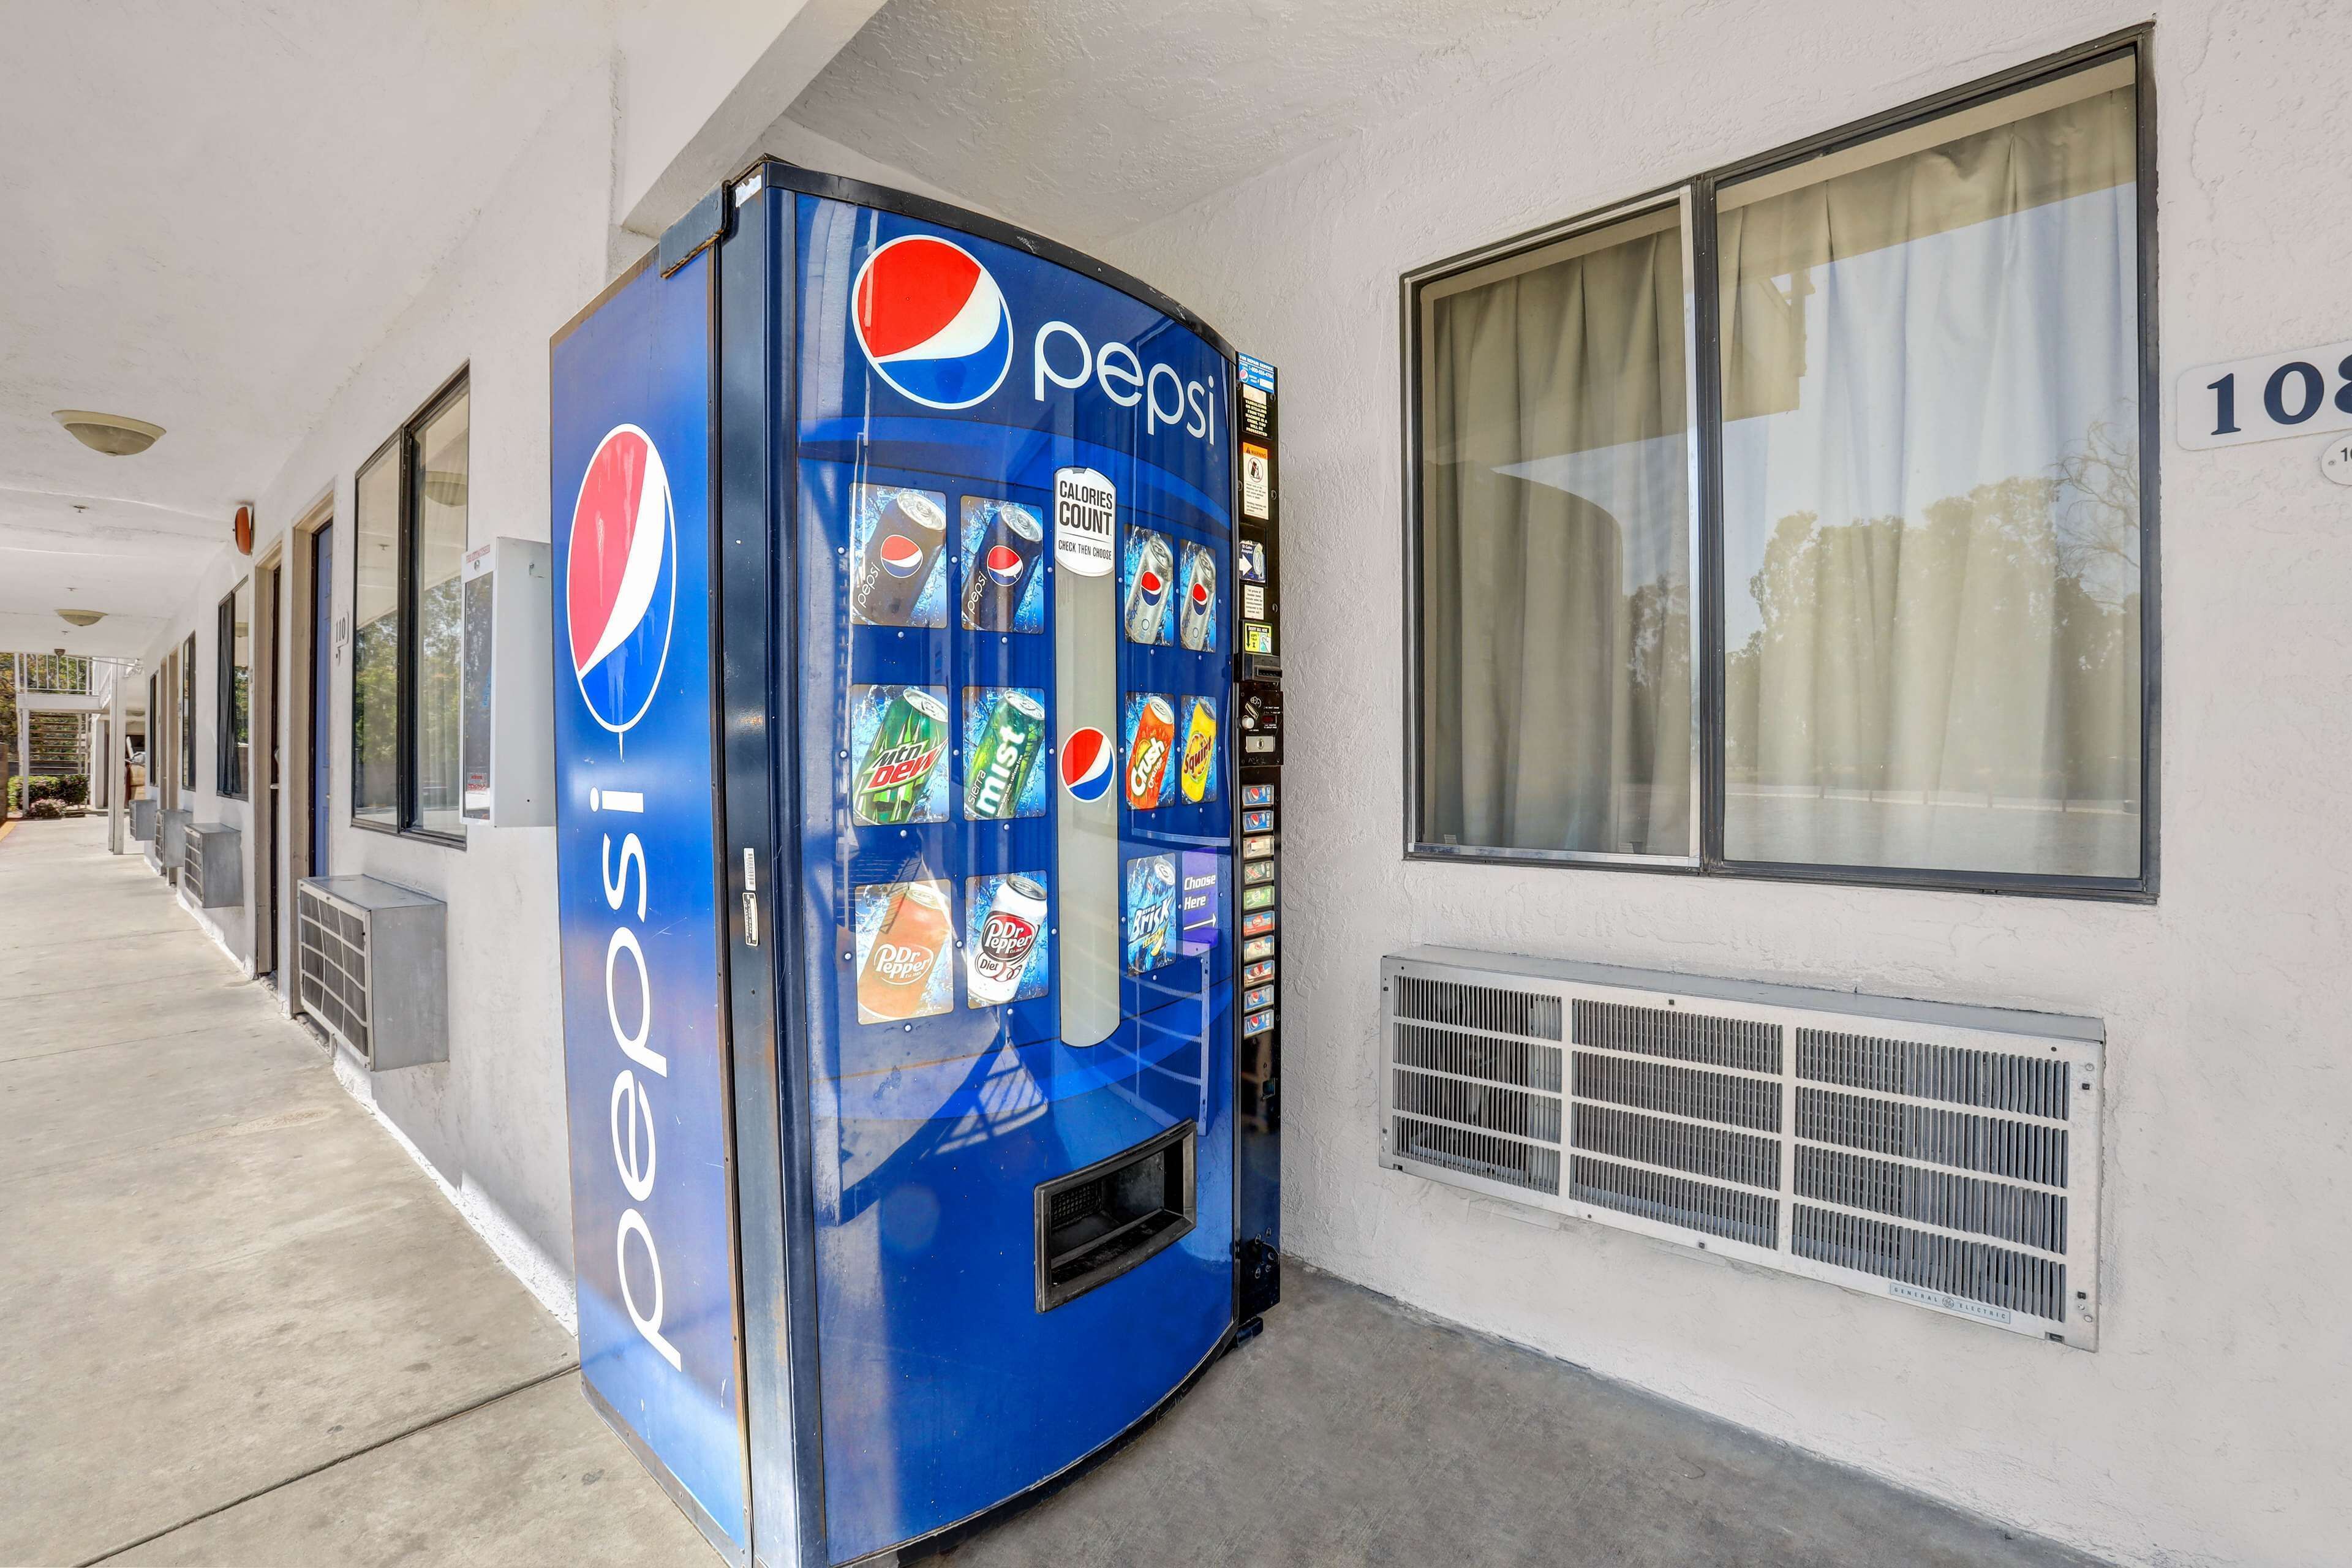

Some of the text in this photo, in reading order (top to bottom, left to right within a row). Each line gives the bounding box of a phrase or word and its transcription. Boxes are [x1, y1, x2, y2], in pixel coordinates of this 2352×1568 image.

[1034, 320, 1215, 446] pepsi
[1060, 480, 1112, 510] CALORIES
[1059, 501, 1112, 535] COUNT
[1058, 540, 1112, 560] CHECK THEN CHOOSE
[858, 562, 880, 608] pepsi
[967, 570, 987, 614] pepsi
[976, 725, 1025, 815] mist
[1130, 737, 1166, 796] Crush
[1184, 735, 1212, 774] Squirt
[1148, 757, 1164, 789] Orange
[1184, 874, 1216, 891] Choose
[1129, 896, 1172, 943] Brisk
[1184, 895, 1206, 910] Here
[984, 919, 1032, 954] Pepper
[1001, 921, 1024, 938] Dr
[875, 943, 931, 979] Pepper
[894, 946, 921, 963] Dr
[980, 959, 999, 971] Diet
[589, 786, 682, 1372] pepsi
[1894, 1287, 1937, 1302] GENERAL
[1959, 1302, 2006, 1319] ELECTRIC
